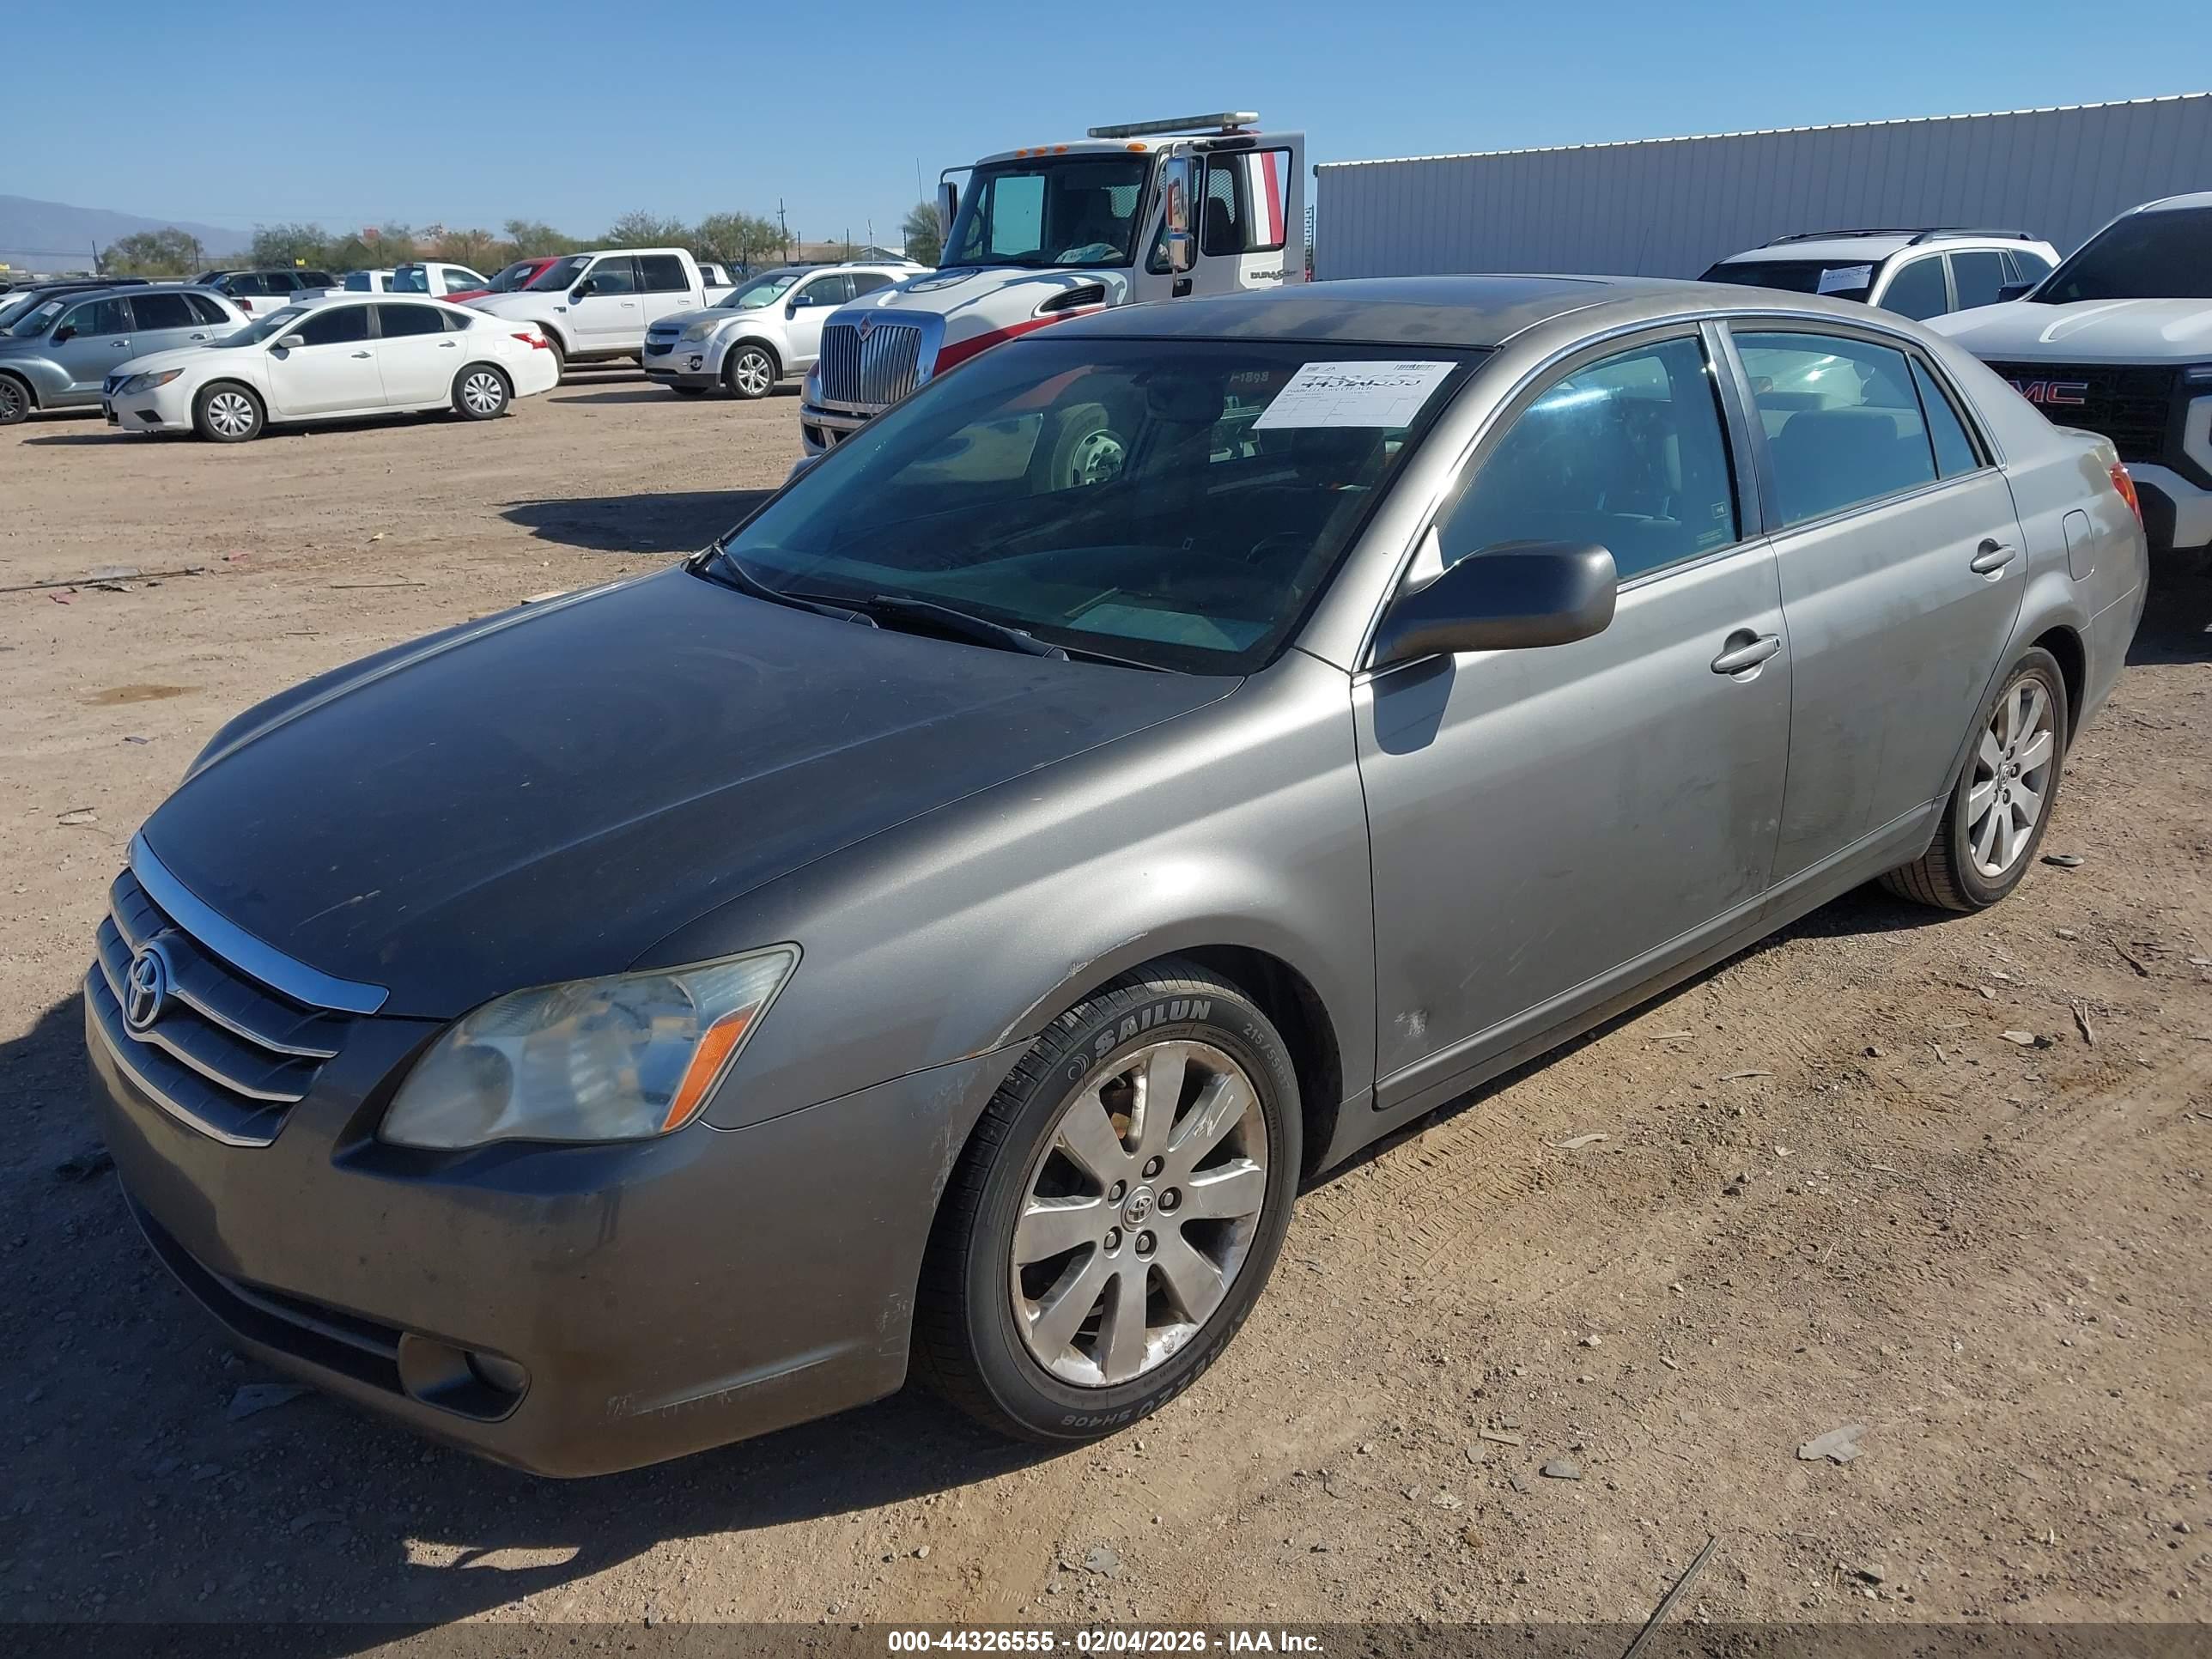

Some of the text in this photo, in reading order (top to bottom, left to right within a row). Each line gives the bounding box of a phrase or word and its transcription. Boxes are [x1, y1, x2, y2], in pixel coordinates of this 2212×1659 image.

[2007, 380, 2088, 404] MC
[1094, 1000, 1212, 1059] SAILUN
[1061, 1409, 1133, 1428] SH408
